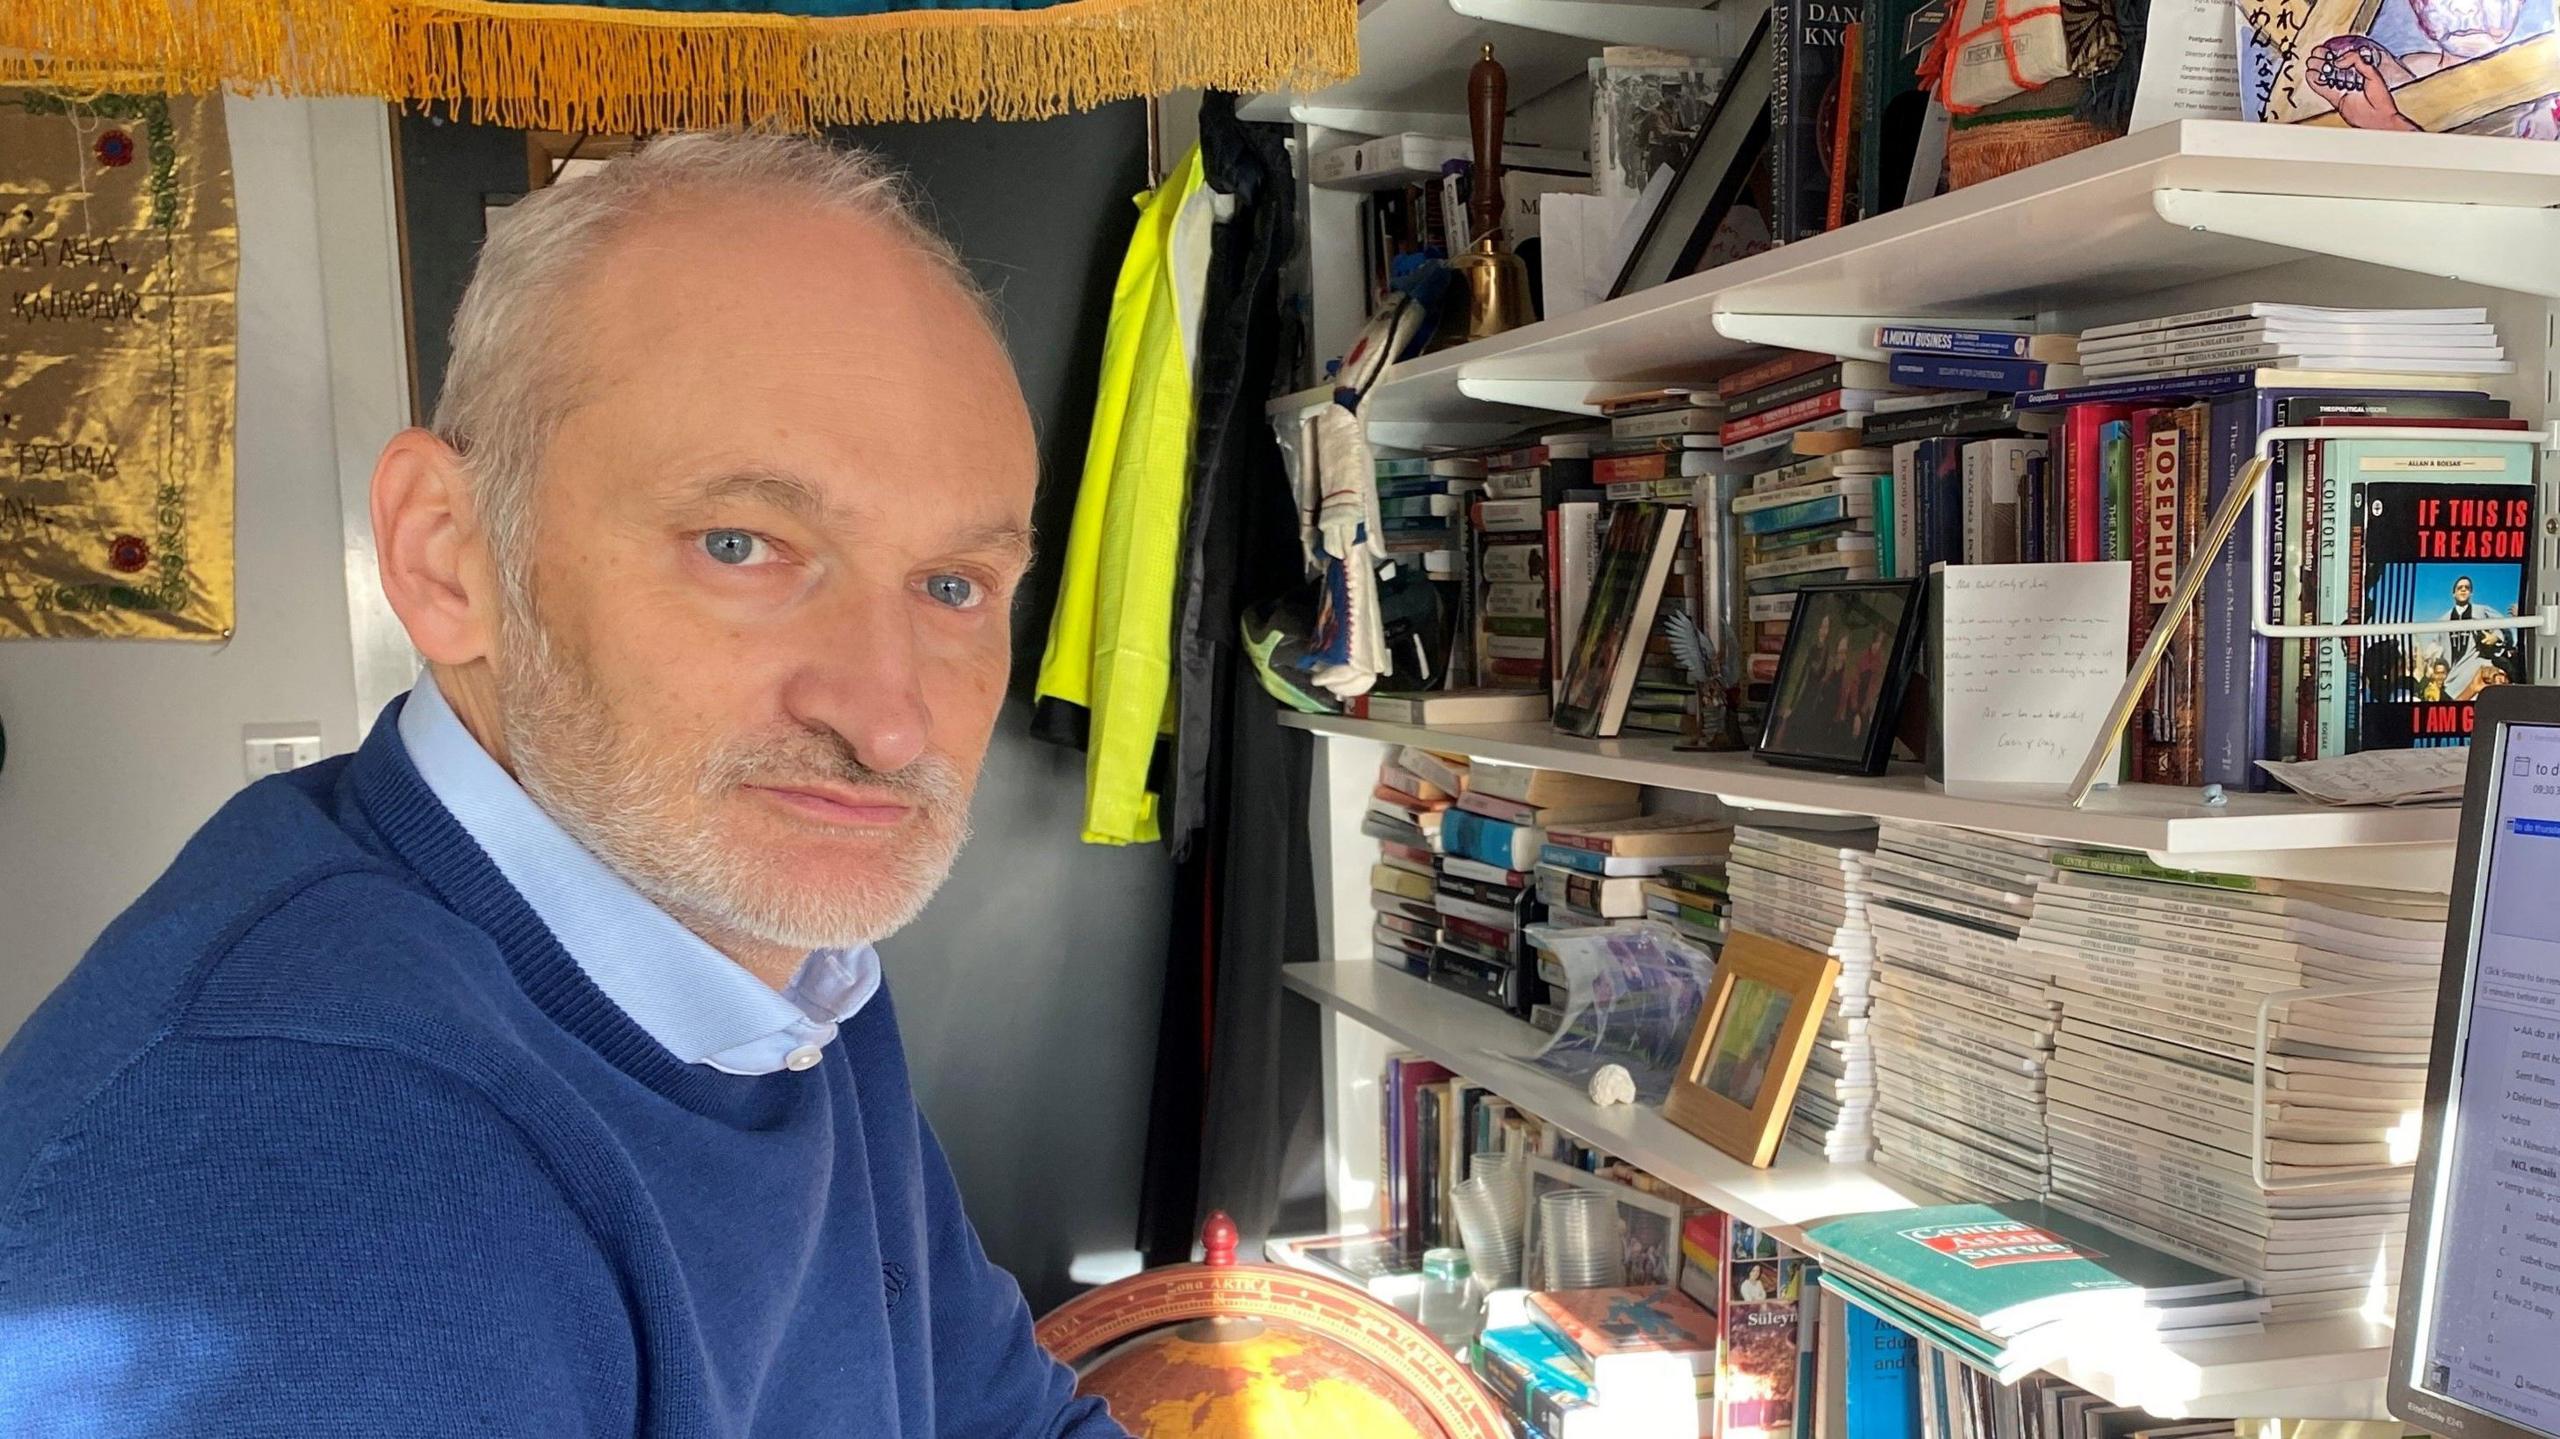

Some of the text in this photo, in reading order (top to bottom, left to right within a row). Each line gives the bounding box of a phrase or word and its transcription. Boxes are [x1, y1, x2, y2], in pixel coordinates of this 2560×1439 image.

[2249, 0, 2279, 122] めんなさい
[2276, 0, 2300, 109] れなくて
[1779, 5, 1789, 126] DANGEROUS
[1882, 332, 1889, 345] A
[1888, 331, 1915, 348] MUCKY
[1915, 332, 1953, 350] BUSINESS
[2319, 405, 2365, 413] THEOPOLITICAL
[2230, 421, 2240, 450] The
[2408, 460, 2462, 468] ALLAN A BOESAK
[2306, 453, 2316, 494] Sunday
[2068, 442, 2077, 540] The Fire Within
[2108, 504, 2117, 526] THE
[2154, 436, 2176, 600] JOSEPHUS
[2272, 403, 2286, 626] LENART BETWEEN BABEL
[2306, 496, 2316, 525] After
[2418, 500, 2528, 527] IF THIS IS
[2303, 528, 2315, 572] Tuesday
[2418, 530, 2525, 558] TREASON
[2226, 580, 2233, 594] of
[2225, 597, 2235, 643] Menno
[2319, 478, 2336, 750] COMFORT ROTEST BOESAK
[2224, 647, 2233, 694] Simons
[2303, 663, 2313, 680] ed.
[2413, 706, 2420, 733] I
[2426, 706, 2457, 733] AM
[2536, 763, 2560, 776] to d
[2524, 824, 2534, 832] do
[2063, 855, 2131, 873] CENTRAL ASIAN SURVEY
[2484, 966, 2499, 976] Click
[2502, 969, 2525, 980] Snooze
[2489, 987, 2515, 998] minutes
[2517, 991, 2539, 1003] before
[2534, 1029, 2545, 1038] do
[2542, 1054, 2550, 1062] at
[2516, 1069, 2533, 1080] Sent
[2512, 1091, 2542, 1106] Deleted
[2529, 1165, 2557, 1178] emails
[2504, 1181, 2525, 1195] temp
[1911, 1222, 2032, 1240] Central
[1950, 1231, 2052, 1250] Asian
[1957, 1243, 2074, 1260] Survey
[2496, 1268, 2503, 1278] D
[1210, 1277, 1272, 1291] ARTICA
[2532, 1281, 2554, 1294] grant
[1874, 1356, 1905, 1371] and
[2486, 1391, 2504, 1404] here
[2504, 1398, 2512, 1408] to
[2513, 1402, 2538, 1416] search
